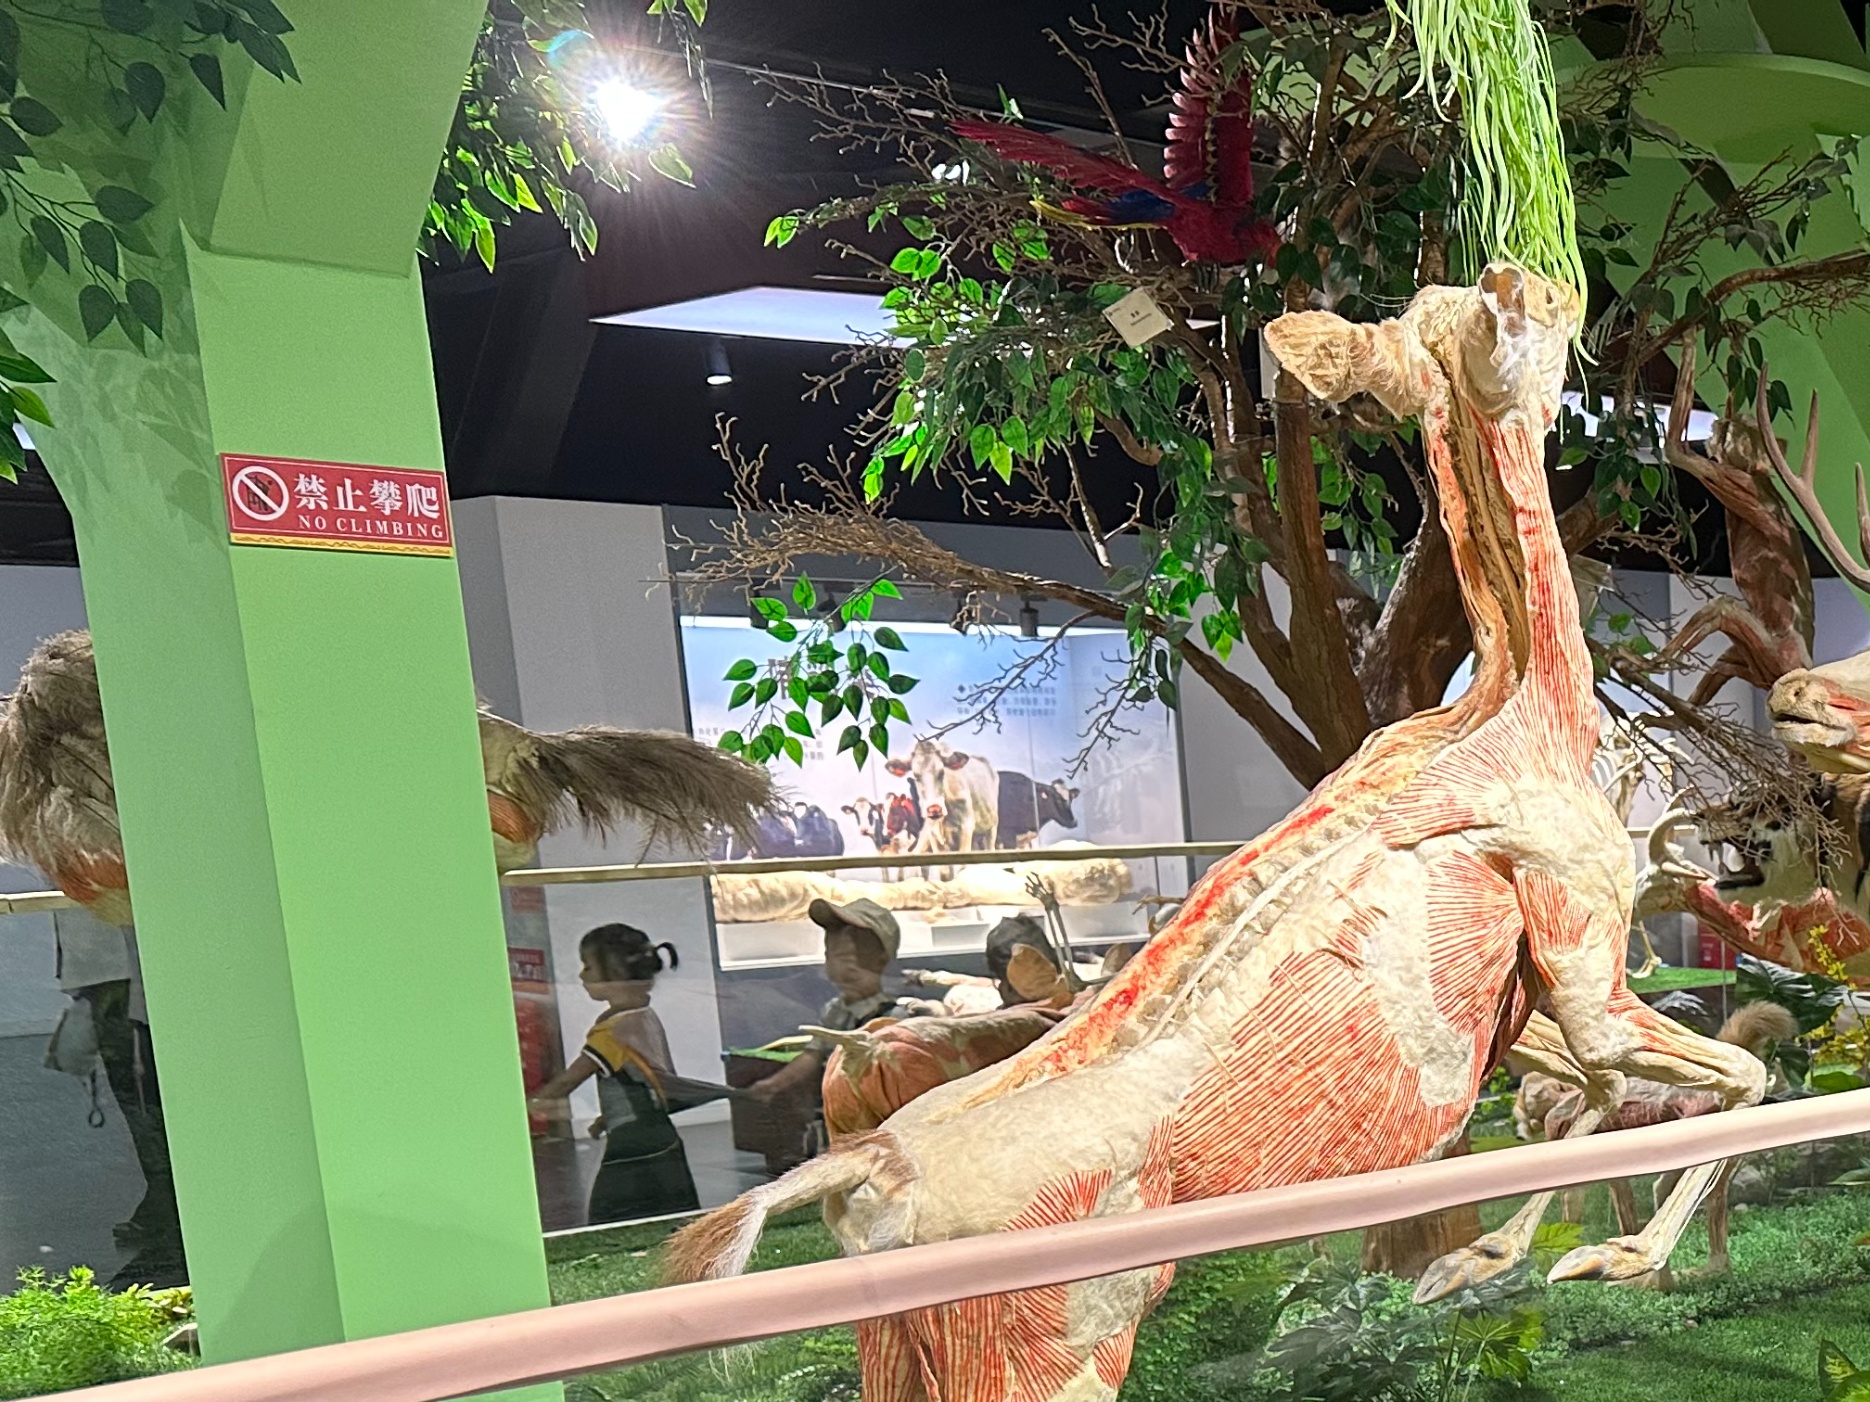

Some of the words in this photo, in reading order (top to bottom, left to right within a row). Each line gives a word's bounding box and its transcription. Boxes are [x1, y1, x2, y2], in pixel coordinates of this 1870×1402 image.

[293, 473, 441, 519] 禁止攀爬
[298, 515, 327, 530] NO
[336, 518, 443, 538] CLIMBING
